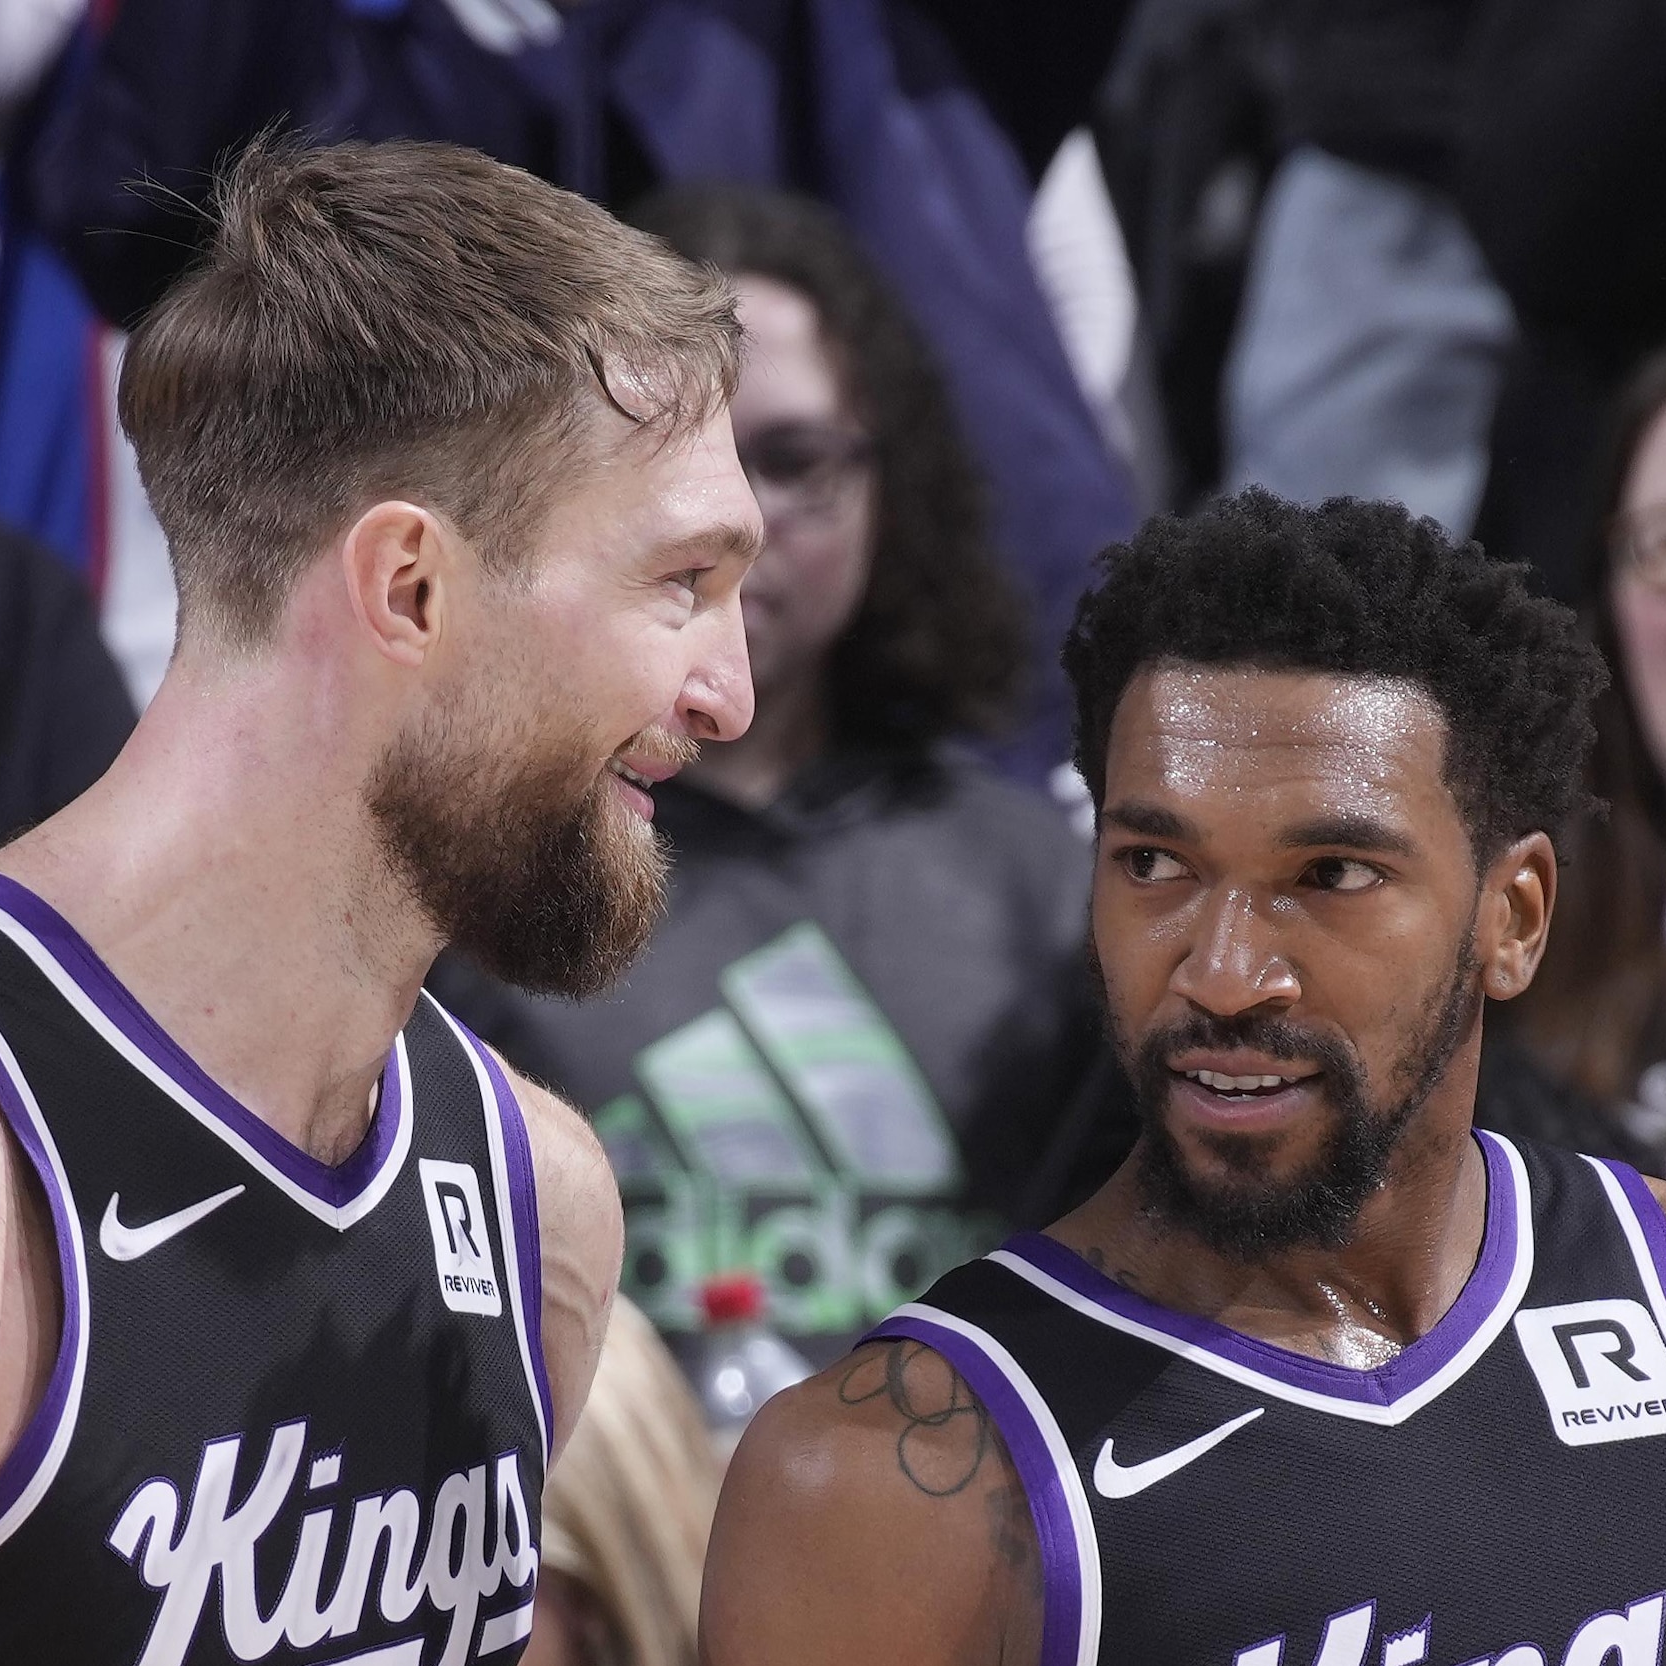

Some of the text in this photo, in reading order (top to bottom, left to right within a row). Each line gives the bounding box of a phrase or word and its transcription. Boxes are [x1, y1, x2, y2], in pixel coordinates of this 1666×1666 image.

[434, 1180, 481, 1258] R
[444, 1274, 496, 1298] REVIVER
[1551, 1318, 1653, 1389] R
